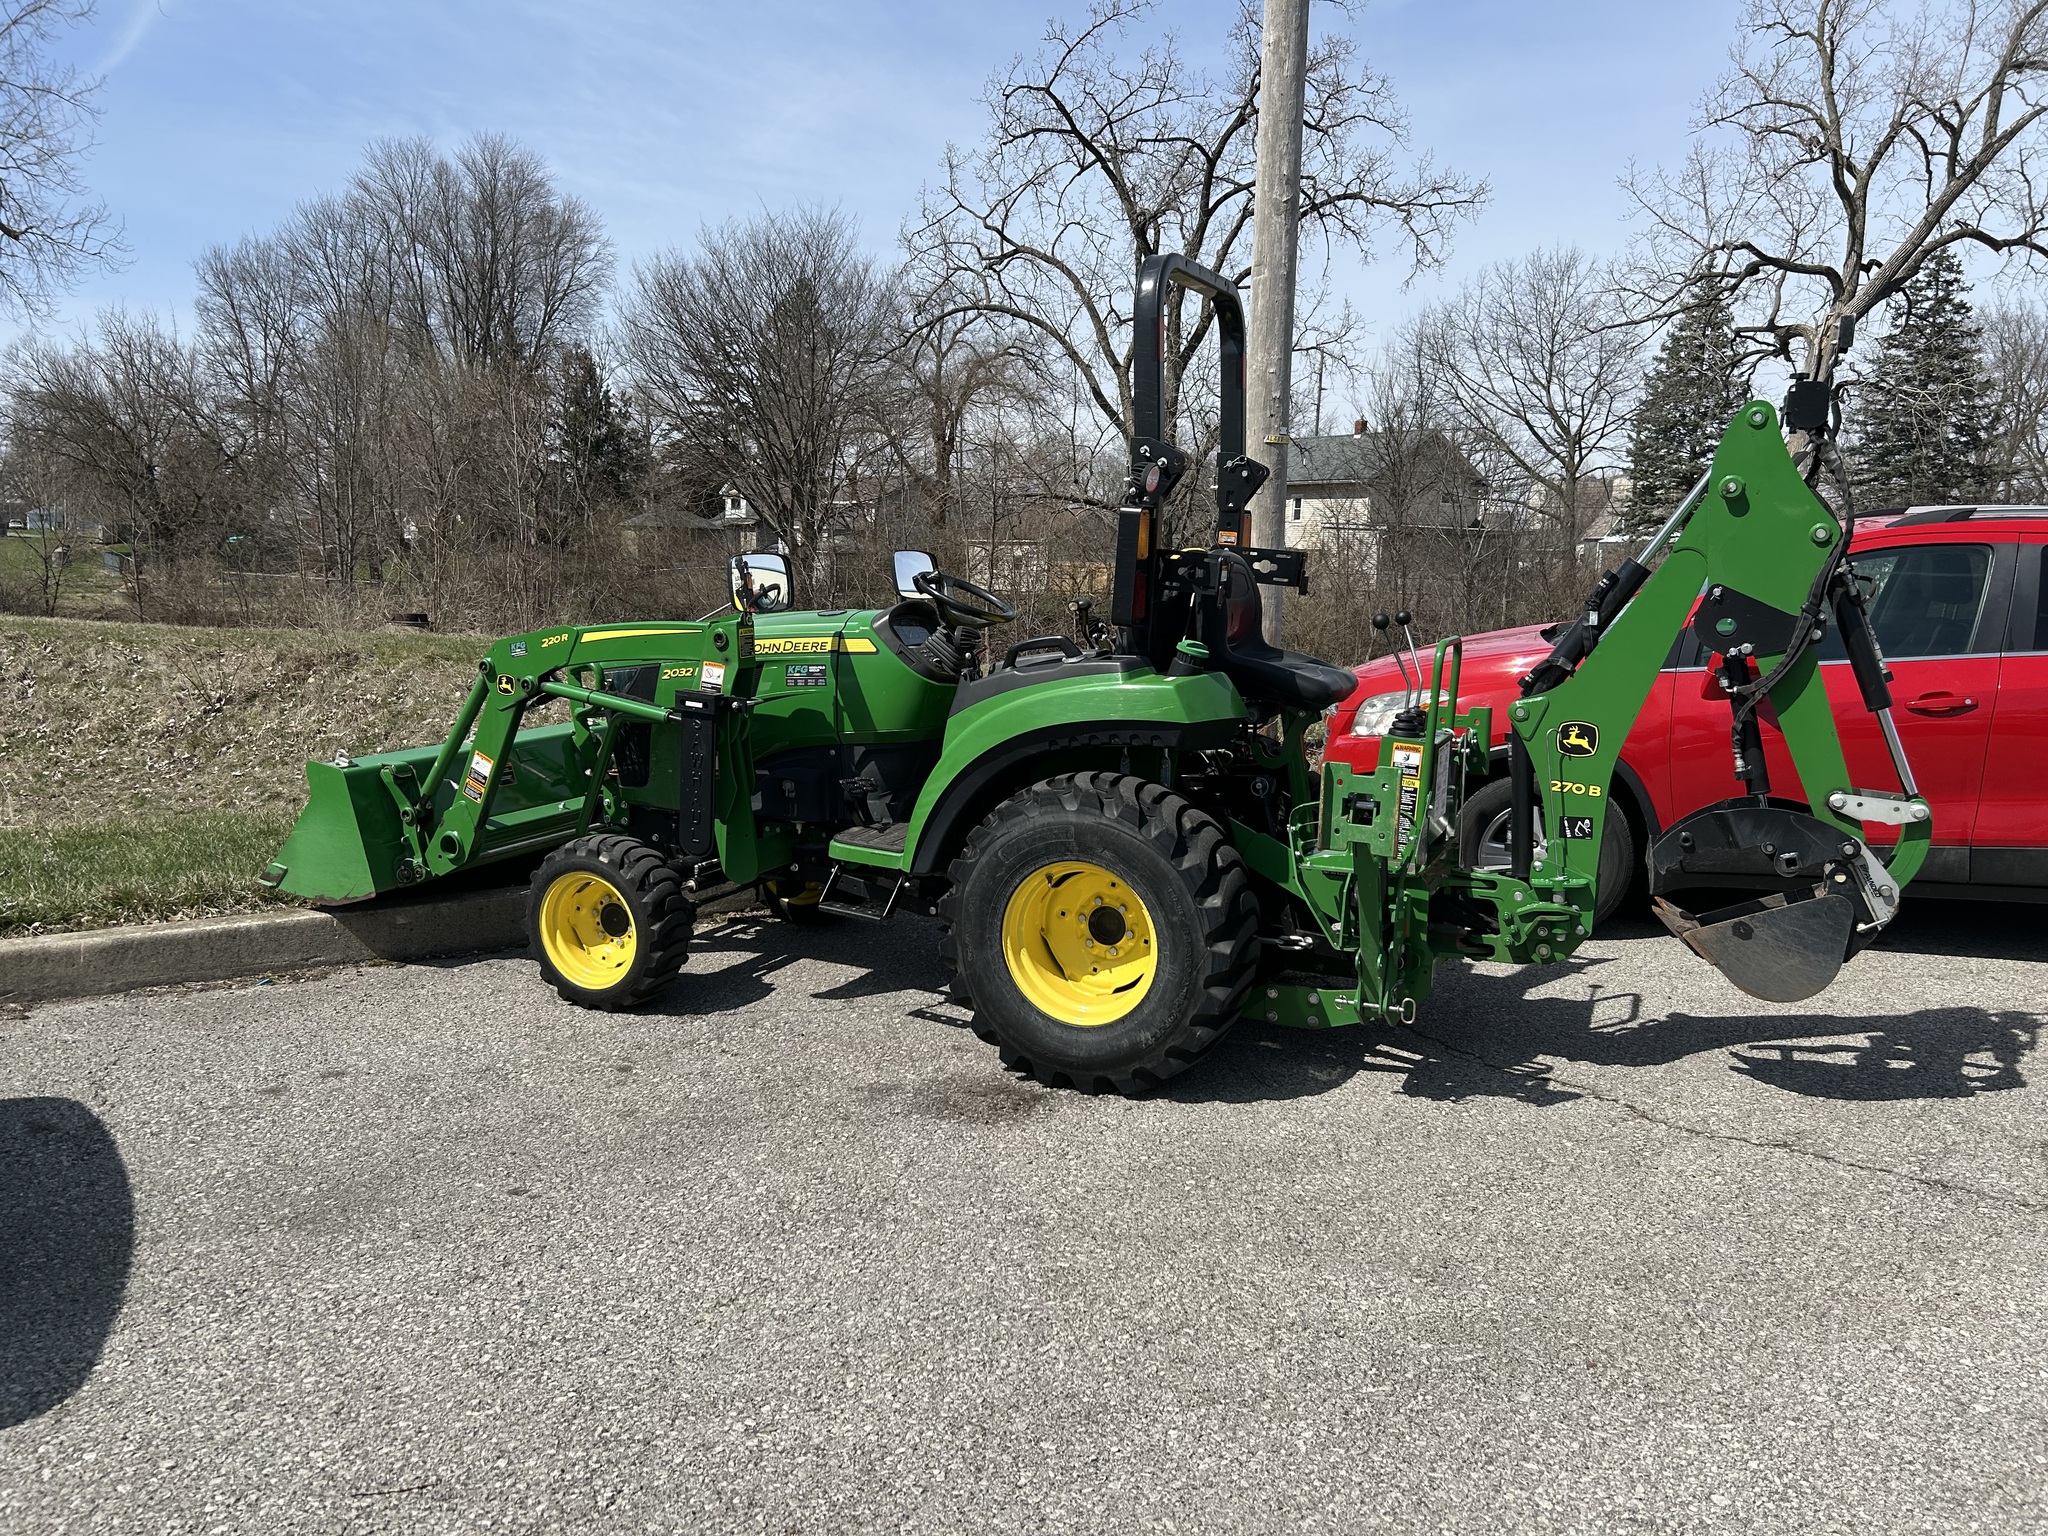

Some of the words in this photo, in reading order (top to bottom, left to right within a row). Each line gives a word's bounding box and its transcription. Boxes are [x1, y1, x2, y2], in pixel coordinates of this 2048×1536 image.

[511, 641, 526, 651] KFG
[541, 635, 561, 648] 220
[754, 643, 781, 653] OHN
[783, 640, 829, 652] DEERE
[787, 665, 808, 674] KFG
[1400, 745, 1421, 753] WARNING
[1550, 780, 1586, 795] 270
